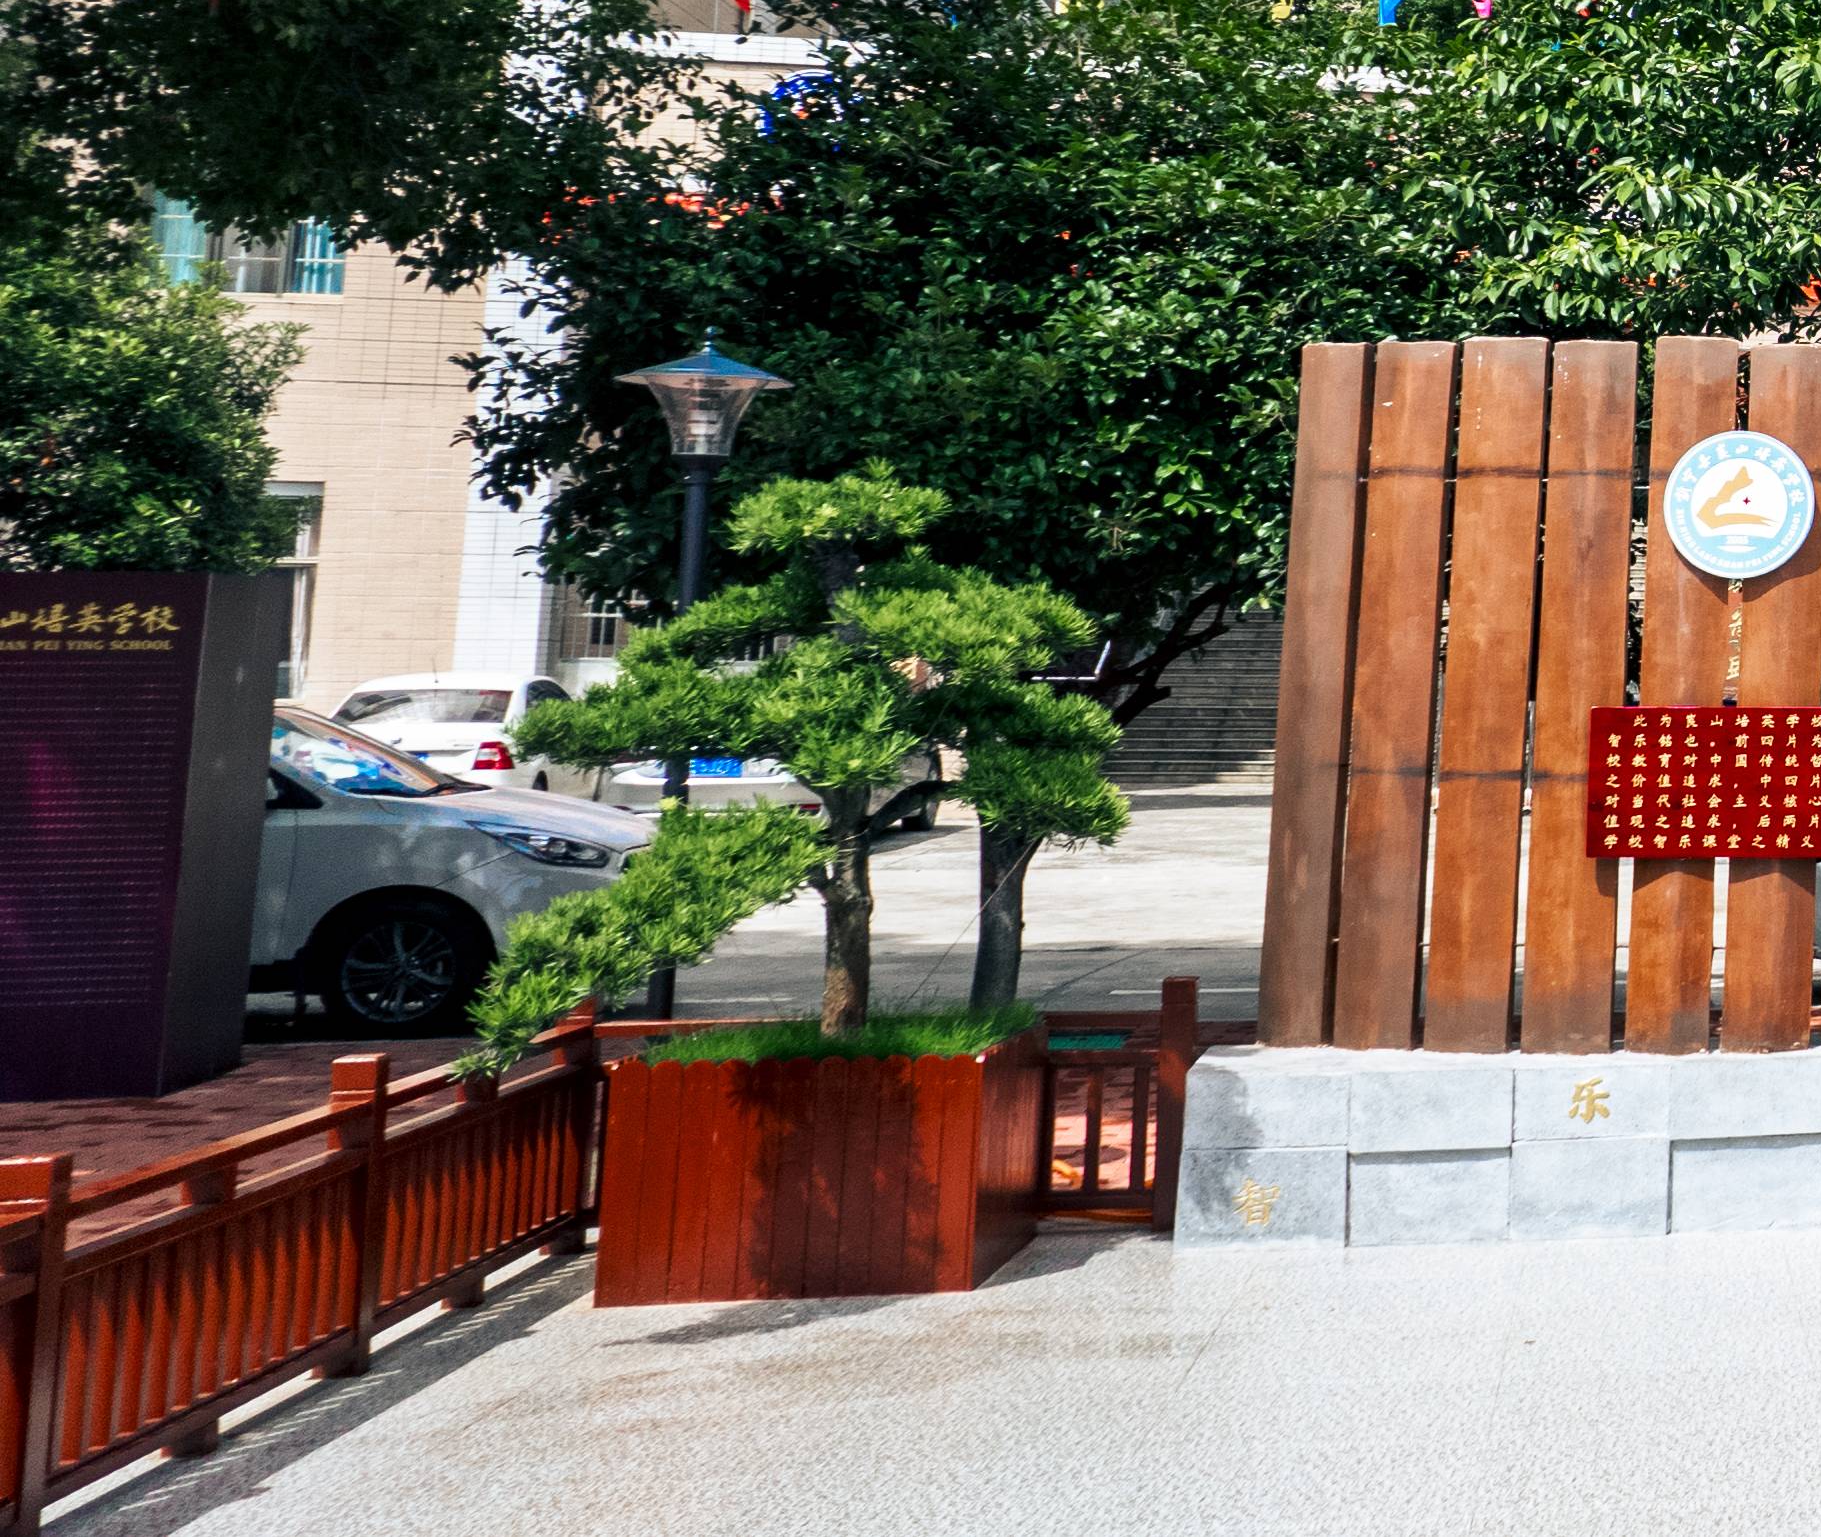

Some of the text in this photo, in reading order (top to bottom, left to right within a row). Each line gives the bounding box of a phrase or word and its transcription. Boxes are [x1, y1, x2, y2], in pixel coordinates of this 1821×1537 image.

[65, 640, 104, 651] YING
[110, 640, 174, 651] SCHOOL
[1567, 1075, 1611, 1125] 乐
[1232, 1178, 1281, 1227] 智
